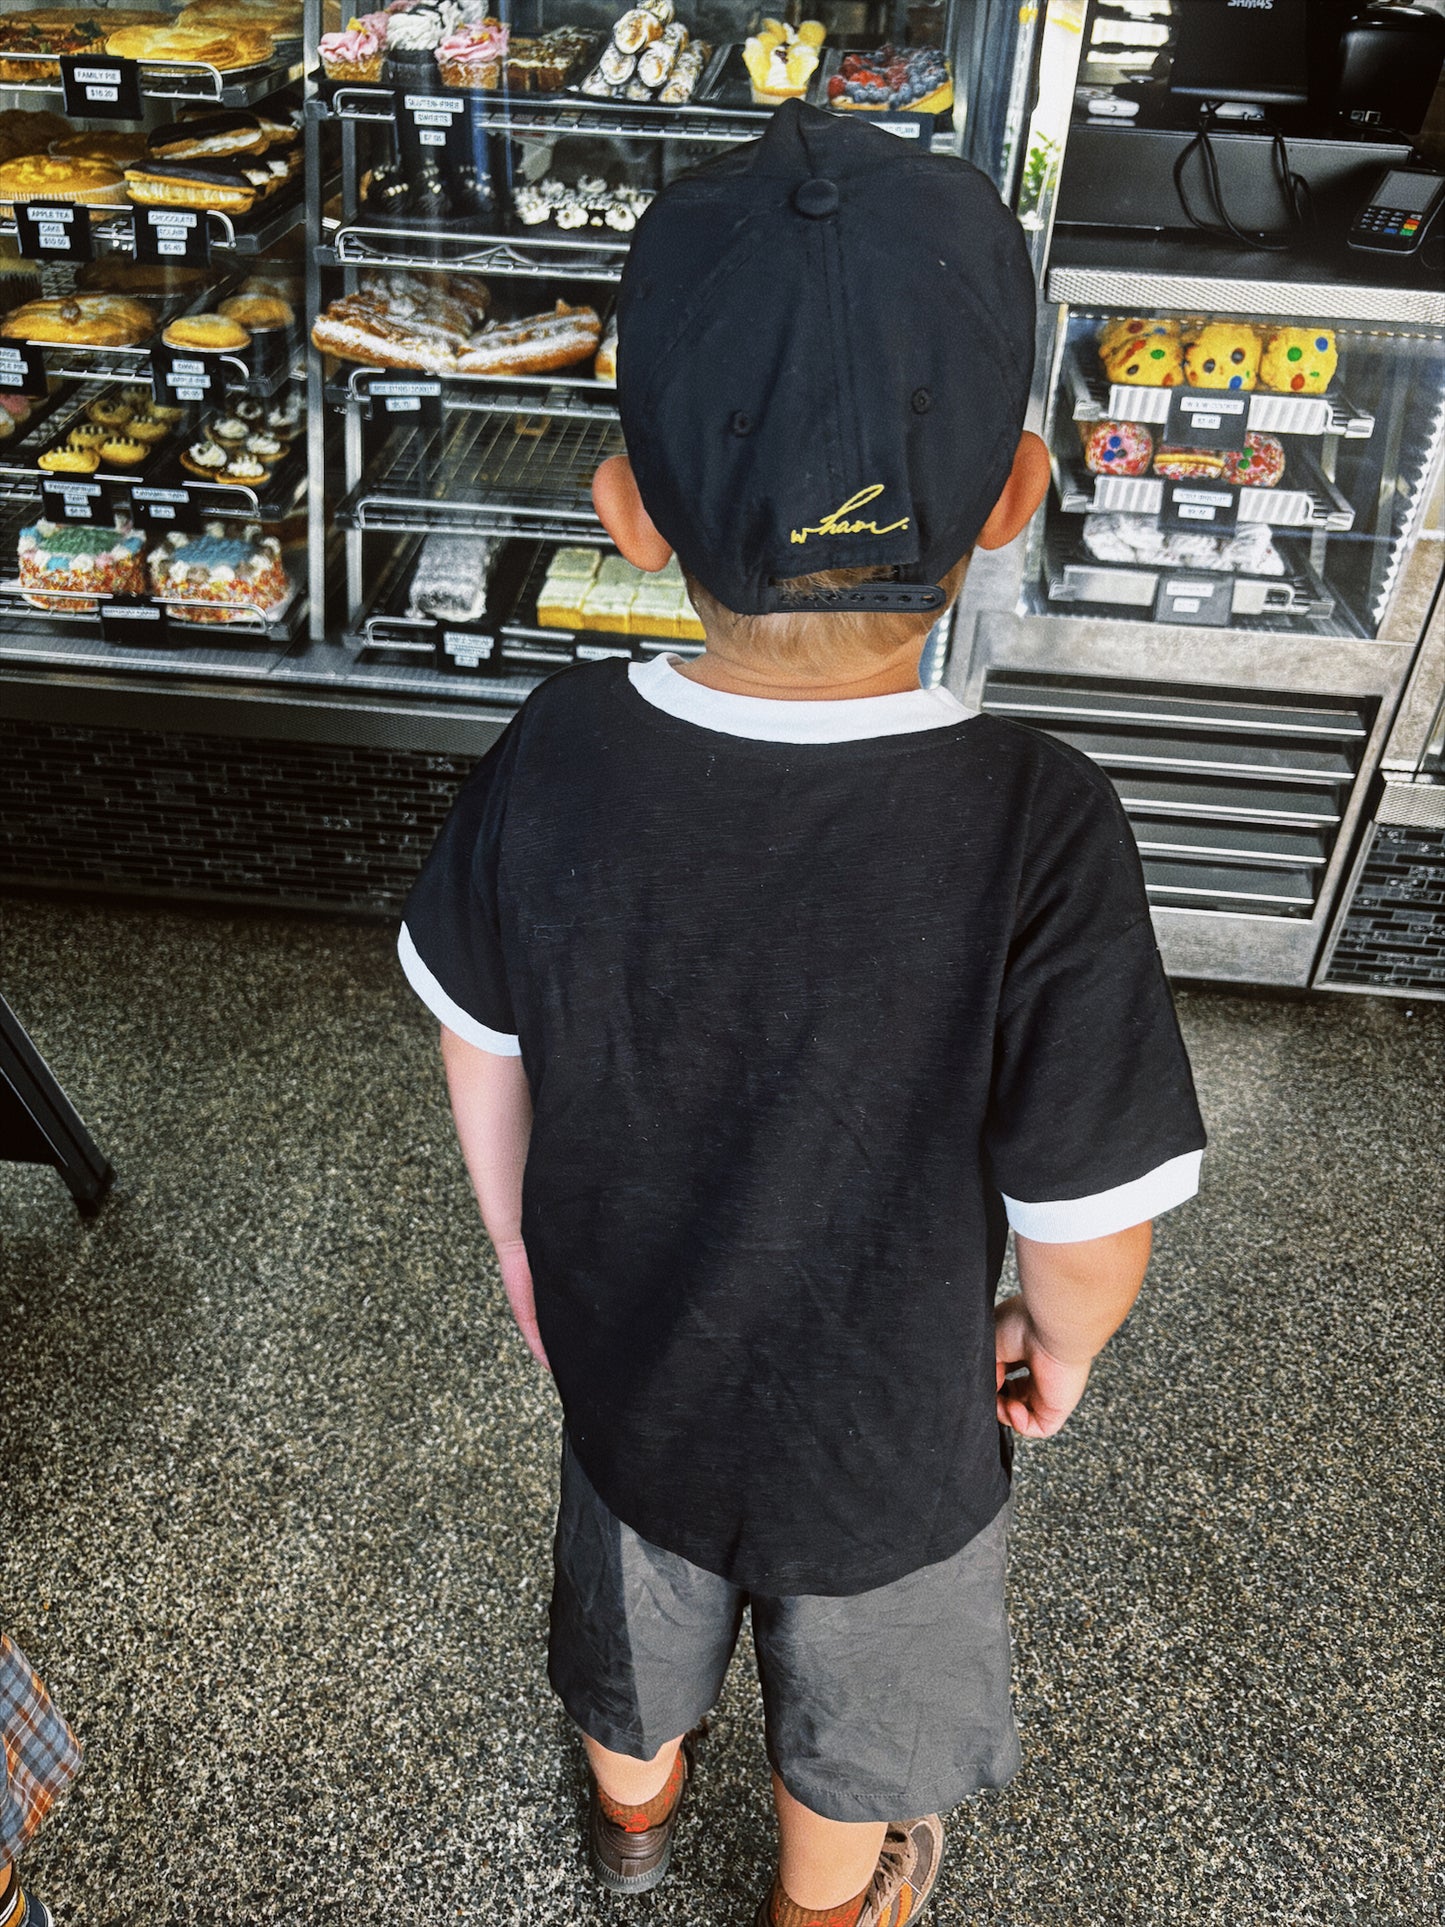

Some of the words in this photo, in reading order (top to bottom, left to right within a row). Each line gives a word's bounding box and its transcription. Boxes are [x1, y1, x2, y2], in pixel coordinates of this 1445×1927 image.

[77, 71, 102, 80] FAMILY
[105, 73, 117, 81] PIE
[31, 210, 54, 219] APPLE
